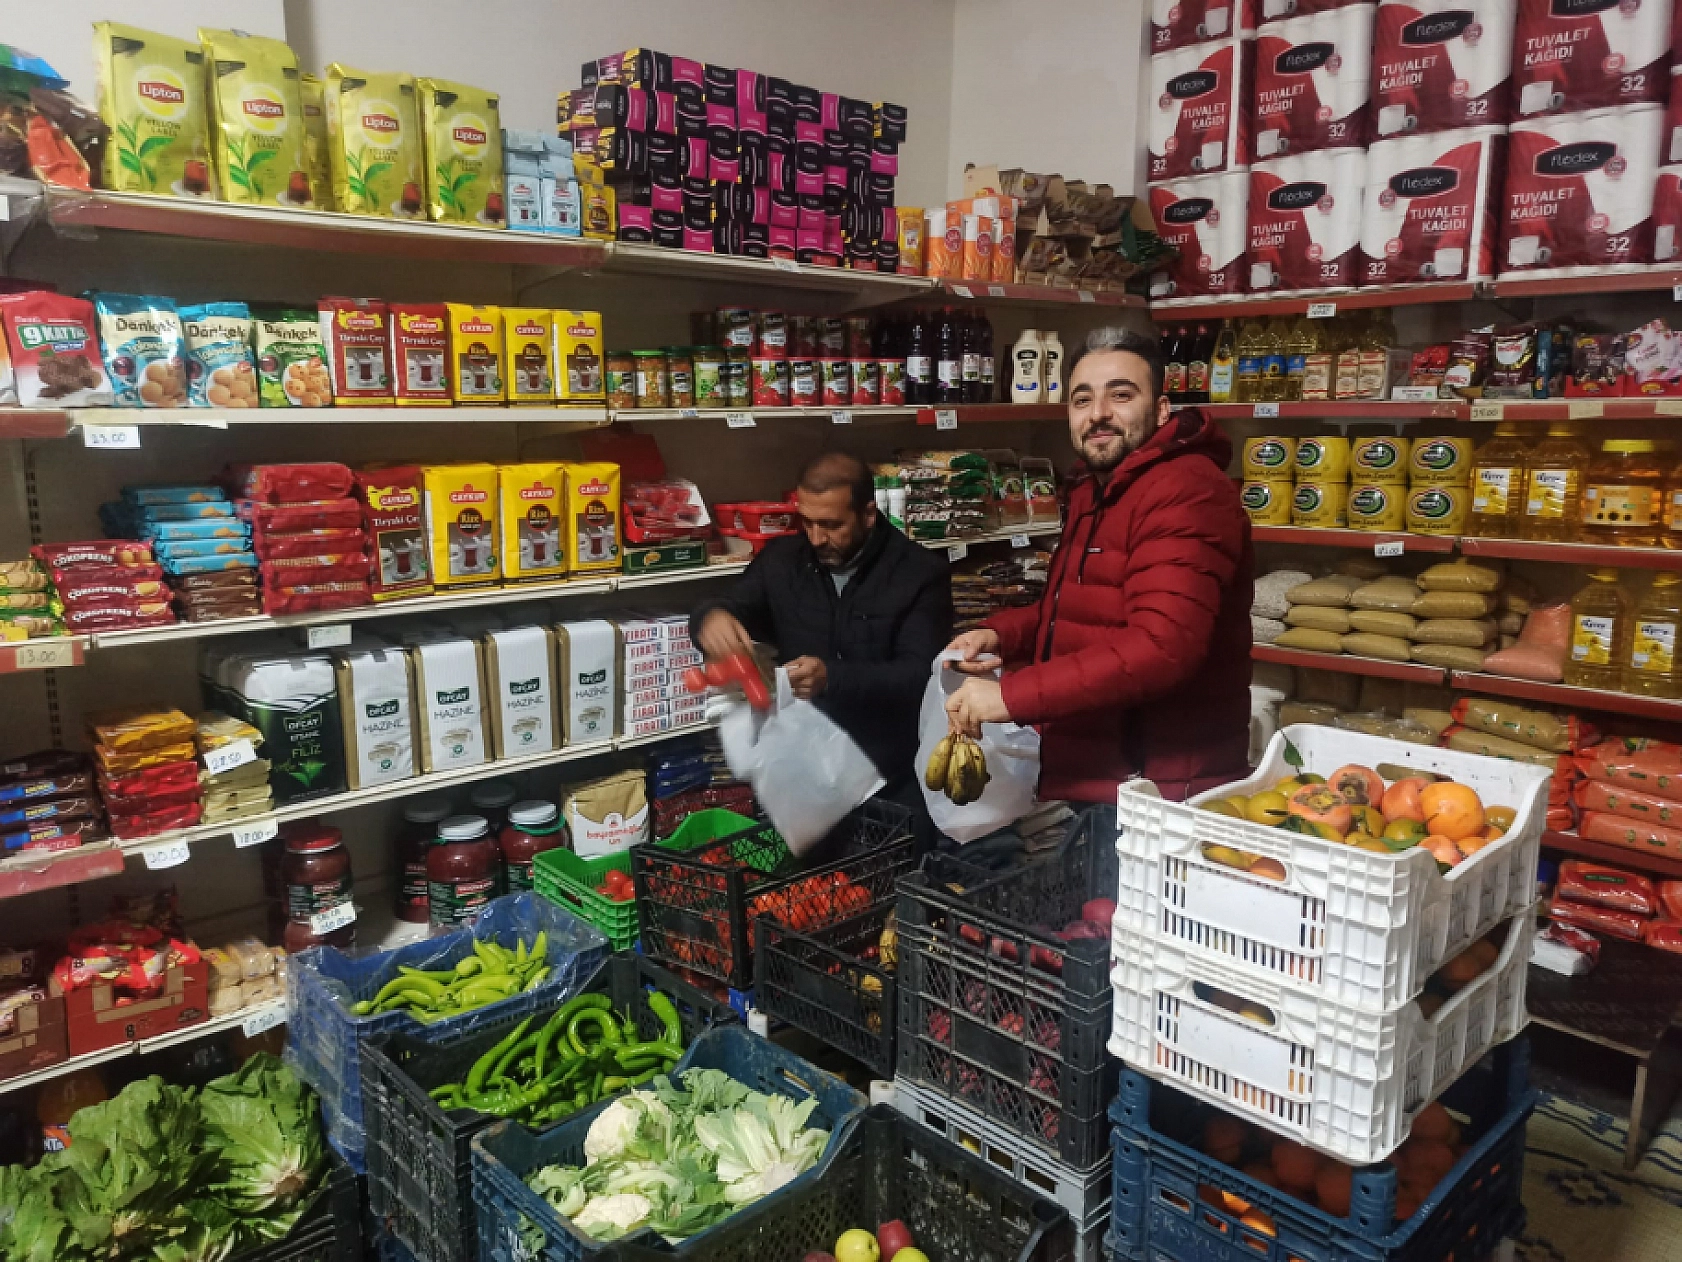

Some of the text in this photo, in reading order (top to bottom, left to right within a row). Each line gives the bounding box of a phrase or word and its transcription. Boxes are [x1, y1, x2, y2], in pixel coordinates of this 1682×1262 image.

[1155, 29, 1171, 43] 32
[1526, 27, 1592, 50] TUVALET
[1380, 55, 1438, 76] TUVALET
[1621, 74, 1646, 92] 32
[141, 84, 181, 100] Lipton
[1259, 83, 1305, 103] TUVALET
[246, 102, 281, 115] Lipton
[1183, 102, 1226, 119] TUVALET
[1466, 99, 1488, 116] 32
[365, 117, 397, 130] Lipton
[1328, 123, 1346, 138] 32
[455, 130, 484, 142] Lipton
[1153, 159, 1168, 172] 32
[1511, 187, 1576, 206] TUVALET
[1410, 204, 1469, 220] TUVALET
[1252, 221, 1298, 236] TUVALET
[1606, 237, 1630, 252] 32
[1321, 264, 1339, 278] 32
[1368, 262, 1387, 276] 32
[1209, 273, 1225, 287] 32
[24, 326, 43, 345] 9
[669, 625, 690, 638] FIRA
[671, 640, 691, 654] FIRA
[44, 1137, 64, 1151] NTA
